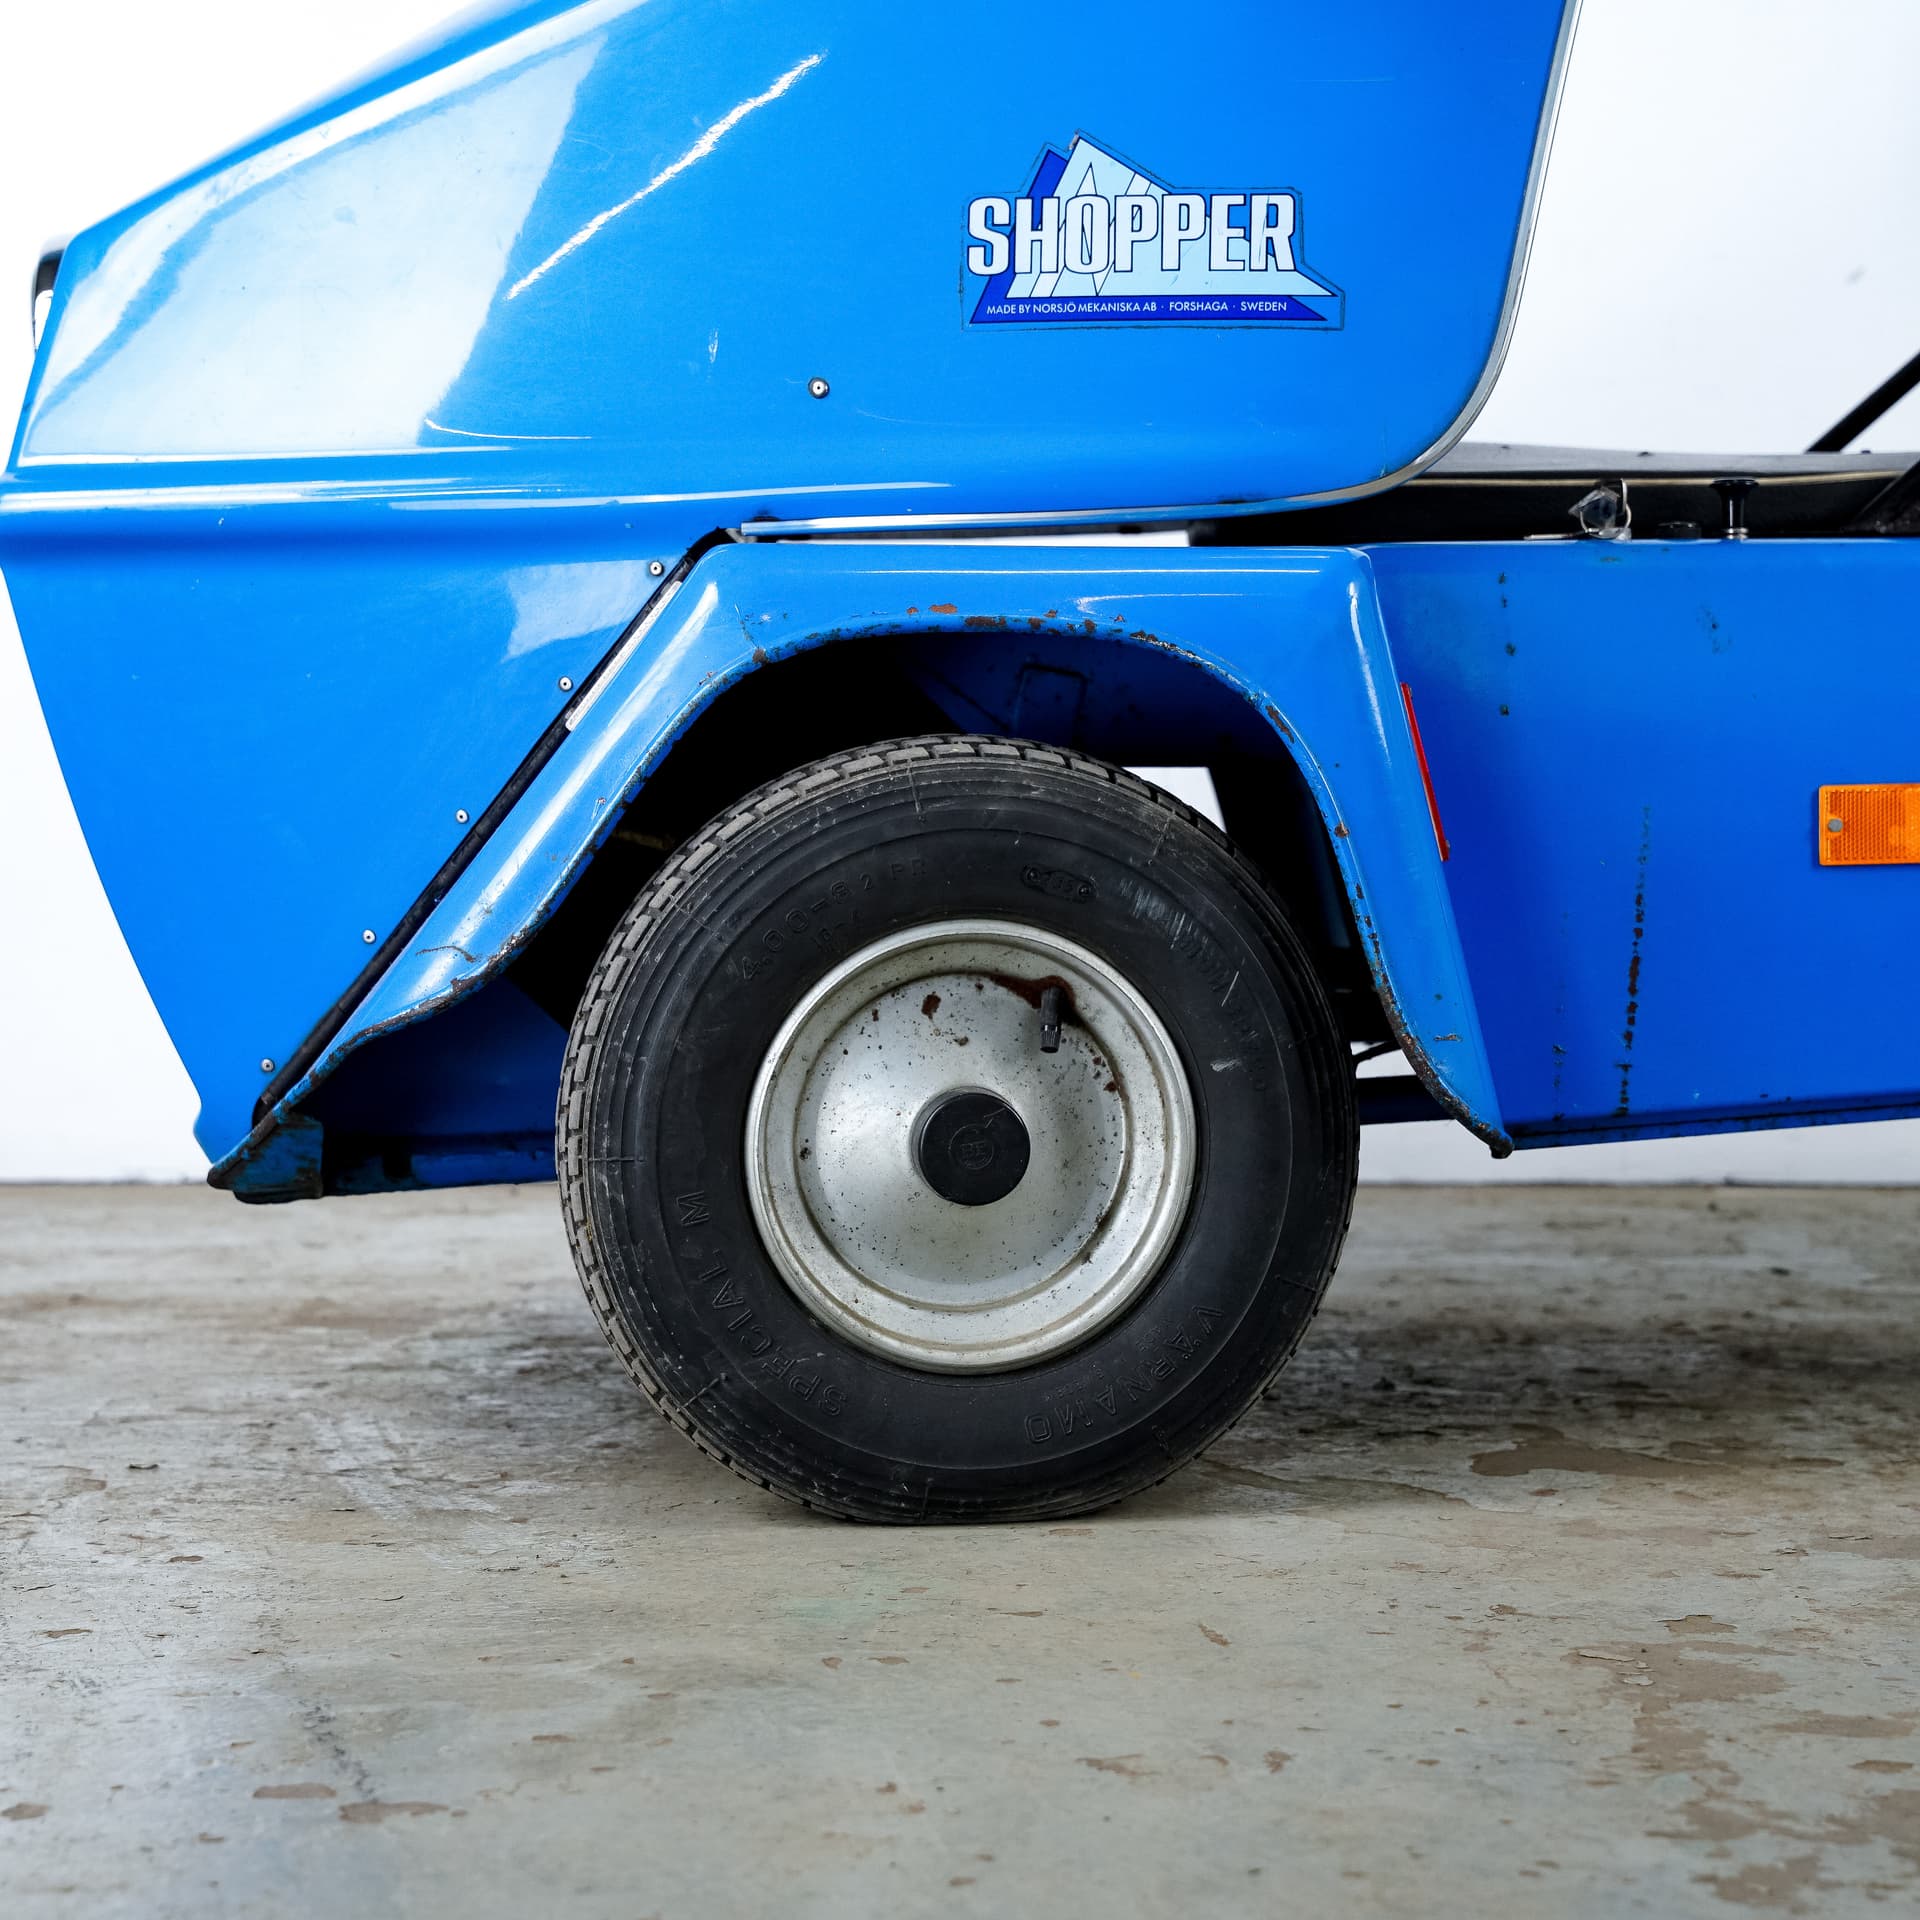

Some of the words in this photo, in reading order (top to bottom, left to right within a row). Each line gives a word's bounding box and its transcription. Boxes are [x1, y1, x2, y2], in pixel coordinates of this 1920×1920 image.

[967, 193, 1297, 275] SHOPPER
[987, 304, 1016, 314] MADE
[1018, 304, 1031, 313] BY
[1033, 302, 1075, 313] NORSJÖ
[1077, 302, 1141, 312] MEKANISKA
[1143, 302, 1157, 312] AB
[1169, 301, 1228, 311] FORSHAGA
[1240, 301, 1287, 311] SWEDEN
[699, 1250, 847, 1416] SPECIAL
[1024, 1305, 1224, 1443] VÄRNAMO
